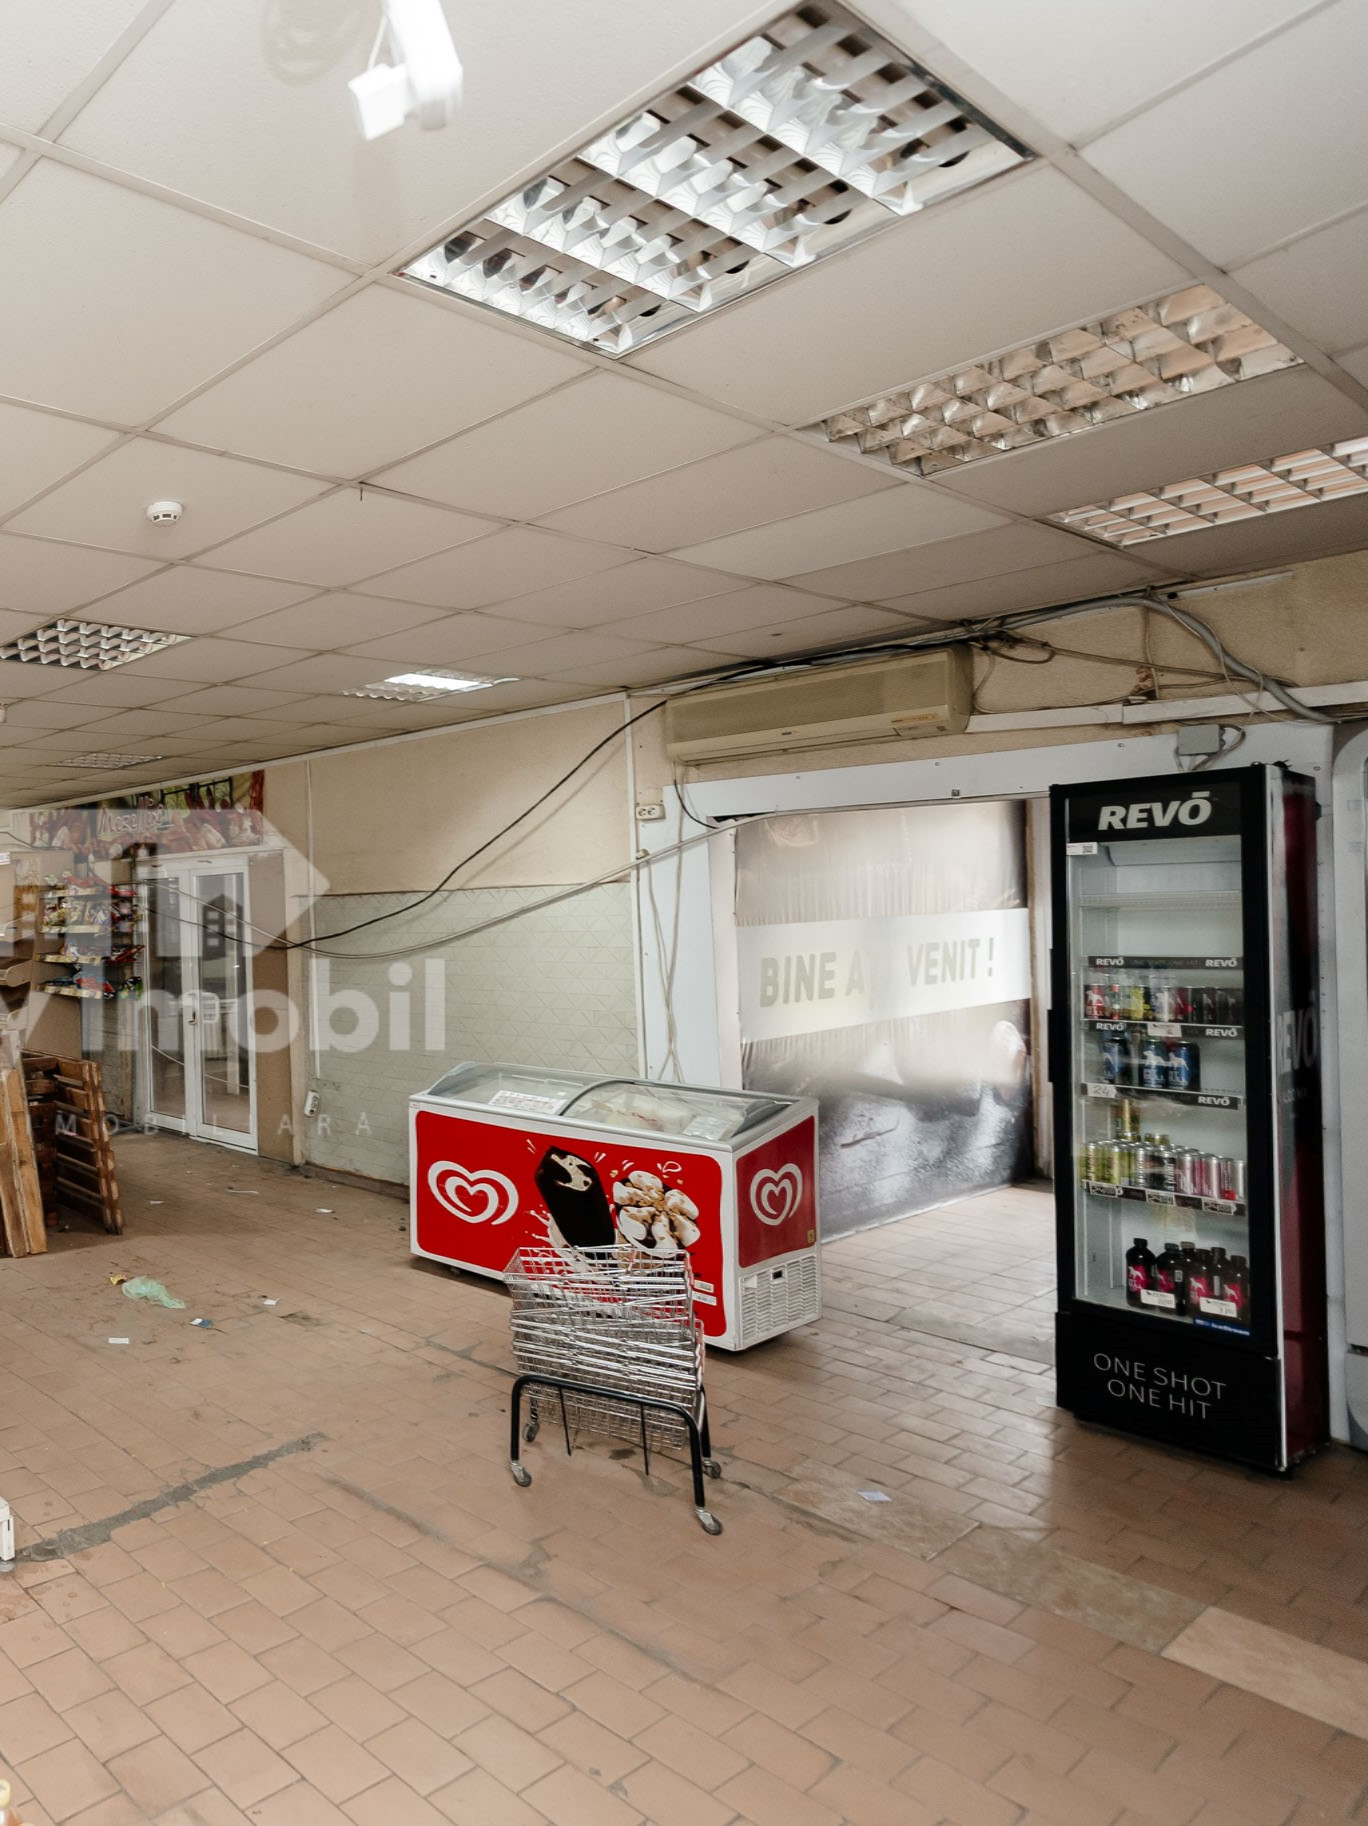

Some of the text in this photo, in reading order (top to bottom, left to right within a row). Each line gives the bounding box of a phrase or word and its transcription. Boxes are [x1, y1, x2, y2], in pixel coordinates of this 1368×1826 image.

[759, 952, 837, 1008] BINE
[1093, 1353, 1227, 1400] ONE SHOT
[1107, 1378, 1211, 1420] ONE HIT
